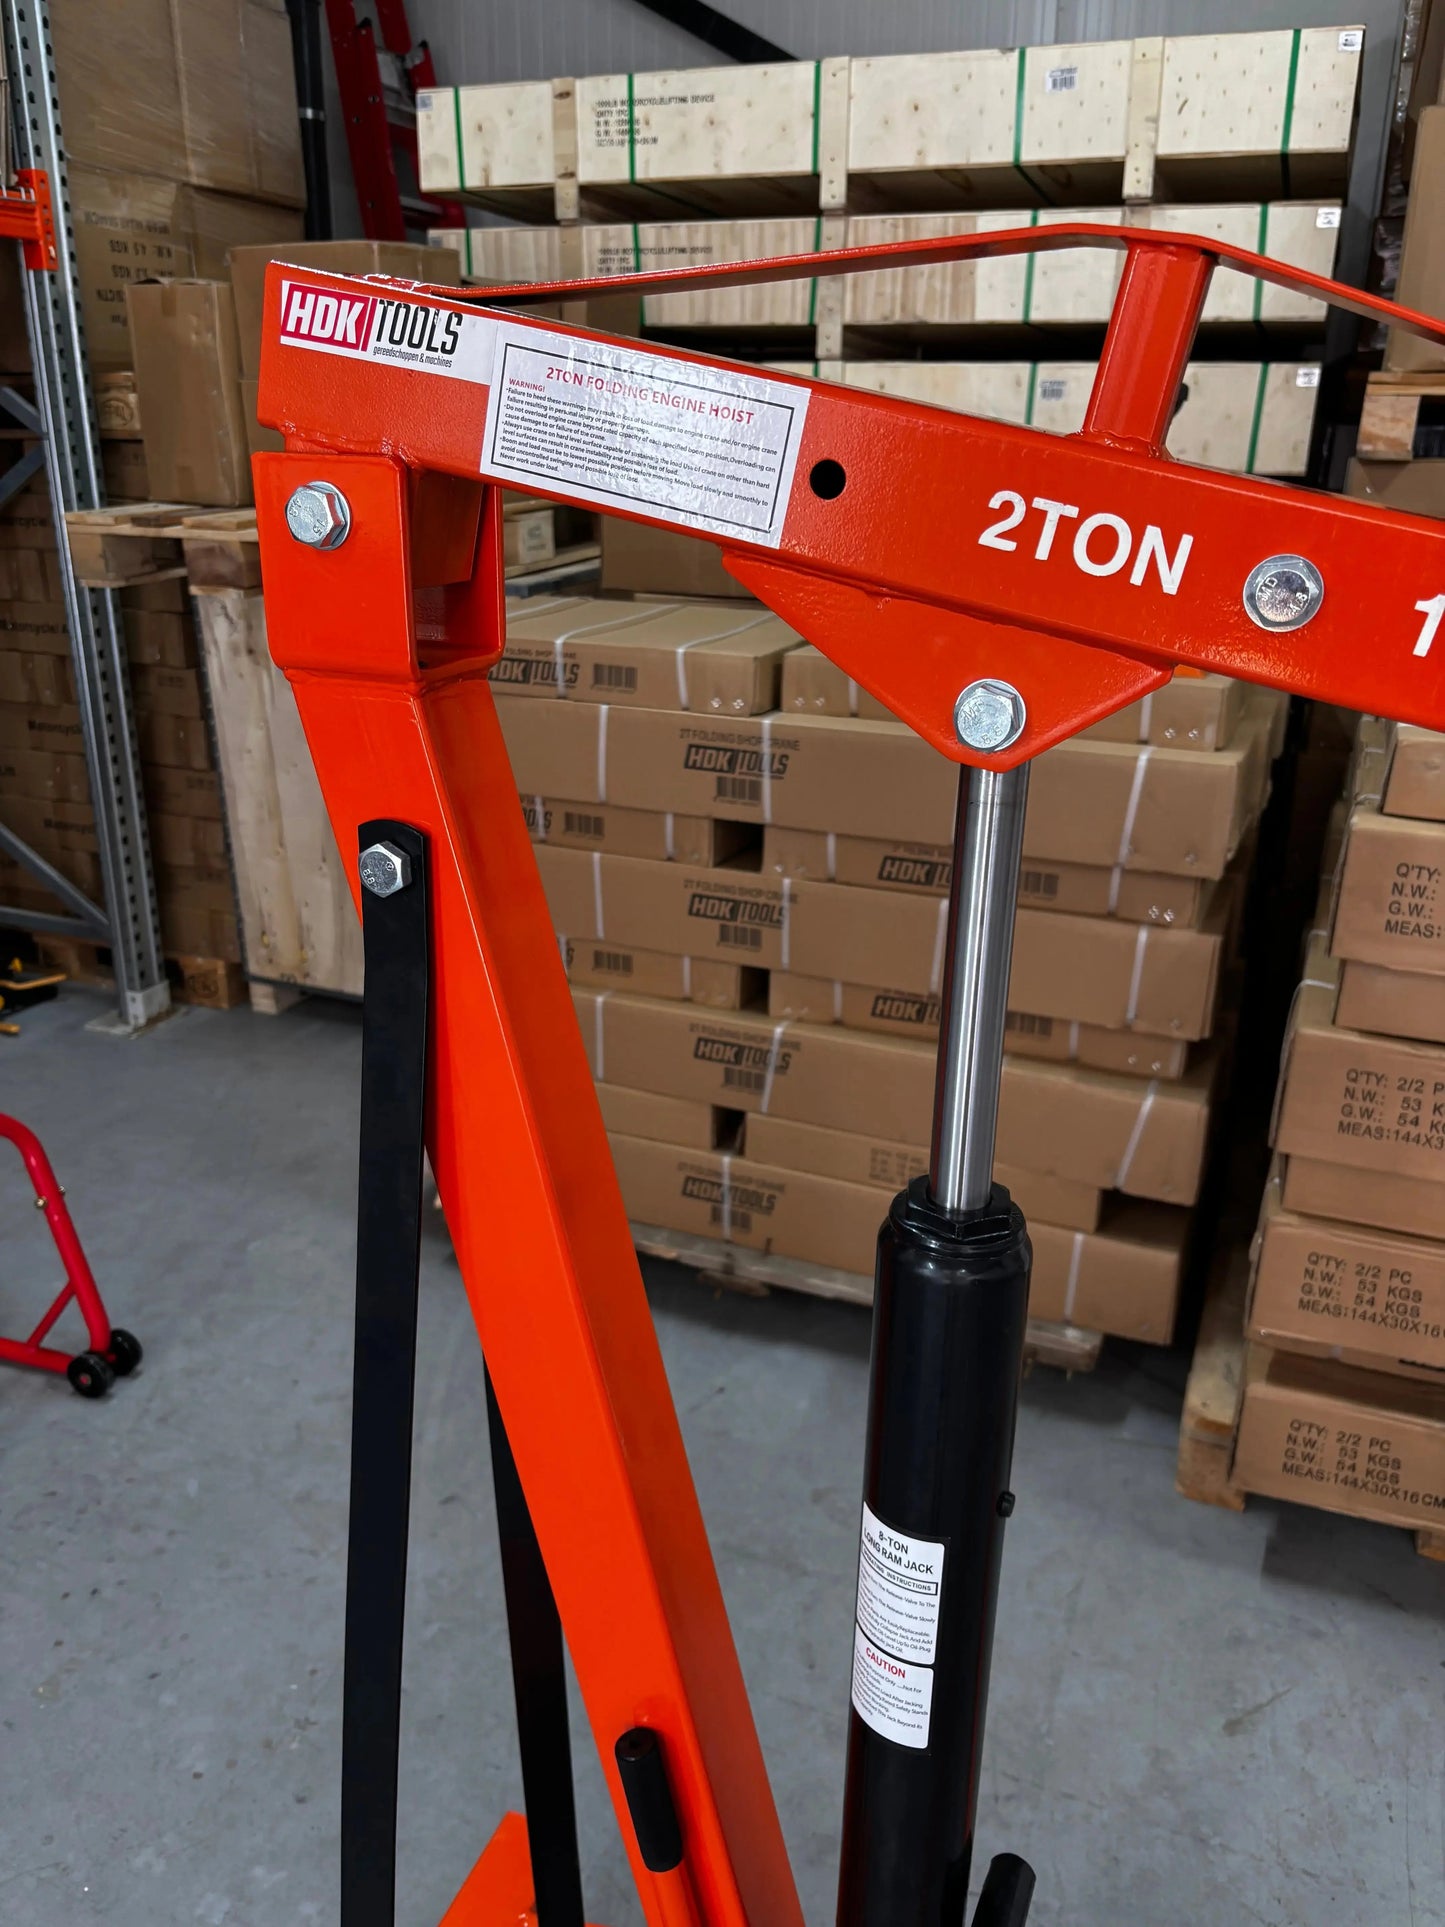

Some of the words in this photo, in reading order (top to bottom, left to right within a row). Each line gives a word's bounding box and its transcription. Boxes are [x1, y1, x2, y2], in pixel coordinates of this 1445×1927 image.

[286, 290, 364, 344] HDK
[376, 298, 463, 354] TOOLS
[373, 346, 419, 362] gereedschappen
[508, 377, 544, 392] WARNING!
[546, 366, 583, 385] 2TON
[586, 375, 648, 400] FOLDING
[651, 390, 706, 414] ENGINE
[708, 403, 754, 425] HOIST
[506, 395, 523, 404] failure
[524, 400, 547, 411] resulting
[578, 412, 594, 422] injury
[520, 415, 541, 426] damage
[555, 423, 572, 433] failure
[524, 409, 547, 418] overload
[548, 414, 566, 423] engine
[582, 421, 603, 431] beyond
[618, 431, 641, 442] capacity
[662, 442, 687, 452] specified
[687, 446, 704, 456] boom
[499, 451, 515, 460] Never
[502, 427, 515, 435] level
[515, 432, 537, 441] surfaces
[585, 447, 612, 461] instability
[623, 458, 646, 467] possible
[503, 419, 522, 430] Always
[555, 432, 568, 440] hard
[568, 435, 581, 443] level
[582, 440, 602, 448] surface
[602, 444, 623, 453] capable
[700, 468, 717, 476] crane
[725, 474, 741, 482] other
[742, 477, 755, 486] than
[755, 480, 770, 489] hard
[501, 435, 517, 444] Boom
[528, 442, 540, 450] load
[569, 452, 587, 461] lowest
[587, 457, 609, 467] possible
[609, 463, 632, 473] position
[633, 467, 651, 477] before
[652, 474, 673, 484] moving
[673, 477, 690, 487] Move
[690, 482, 703, 490] load
[703, 486, 721, 496] slowly
[734, 494, 761, 506] smoothly
[515, 448, 549, 460] uncontrolled
[549, 456, 573, 468] swinging
[584, 465, 607, 475] possible
[978, 491, 1193, 595] 2TON
[531, 660, 580, 684] TOLS
[763, 738, 800, 751] RANE
[687, 746, 732, 772] HDK
[881, 858, 930, 884] HDK
[1396, 862, 1442, 884] Q'TY:
[1392, 882, 1436, 900] N.W.:
[692, 896, 736, 920] HDK
[1388, 900, 1433, 919] G.W.:
[1384, 919, 1442, 939] MEAS:
[874, 996, 921, 1022] HDK
[697, 1040, 738, 1064] HDK
[1346, 1068, 1388, 1088] Q'TY:
[1397, 1076, 1424, 1094] 2/2
[1433, 1082, 1445, 1095] P
[1344, 1086, 1385, 1106] N.W.:
[1401, 1096, 1422, 1112] 53
[1432, 1102, 1445, 1117] K
[1341, 1102, 1382, 1122] G.W.:
[1397, 1112, 1420, 1128] 54
[1338, 1120, 1445, 1151] MEAS:144X3
[1308, 1252, 1346, 1272] Q'TY:
[1355, 1262, 1381, 1280] 2/2
[1389, 1268, 1412, 1285] PC
[1388, 1285, 1422, 1303] KGS
[1298, 1297, 1445, 1338] MEAS:144X30X16
[1384, 1301, 1420, 1318] KGS
[1336, 1430, 1362, 1447] 2/2
[1368, 1437, 1392, 1453] PC
[1367, 1453, 1401, 1470] KGS
[1365, 1468, 1400, 1486] KGS
[864, 1527, 880, 1552] LONG
[882, 1548, 902, 1566] RAM
[904, 1560, 934, 1575] JACK
[878, 1530, 908, 1554] 8-TON
[886, 1572, 932, 1592] INSTRUCTIONS
[866, 1647, 906, 1678] CAUTION
